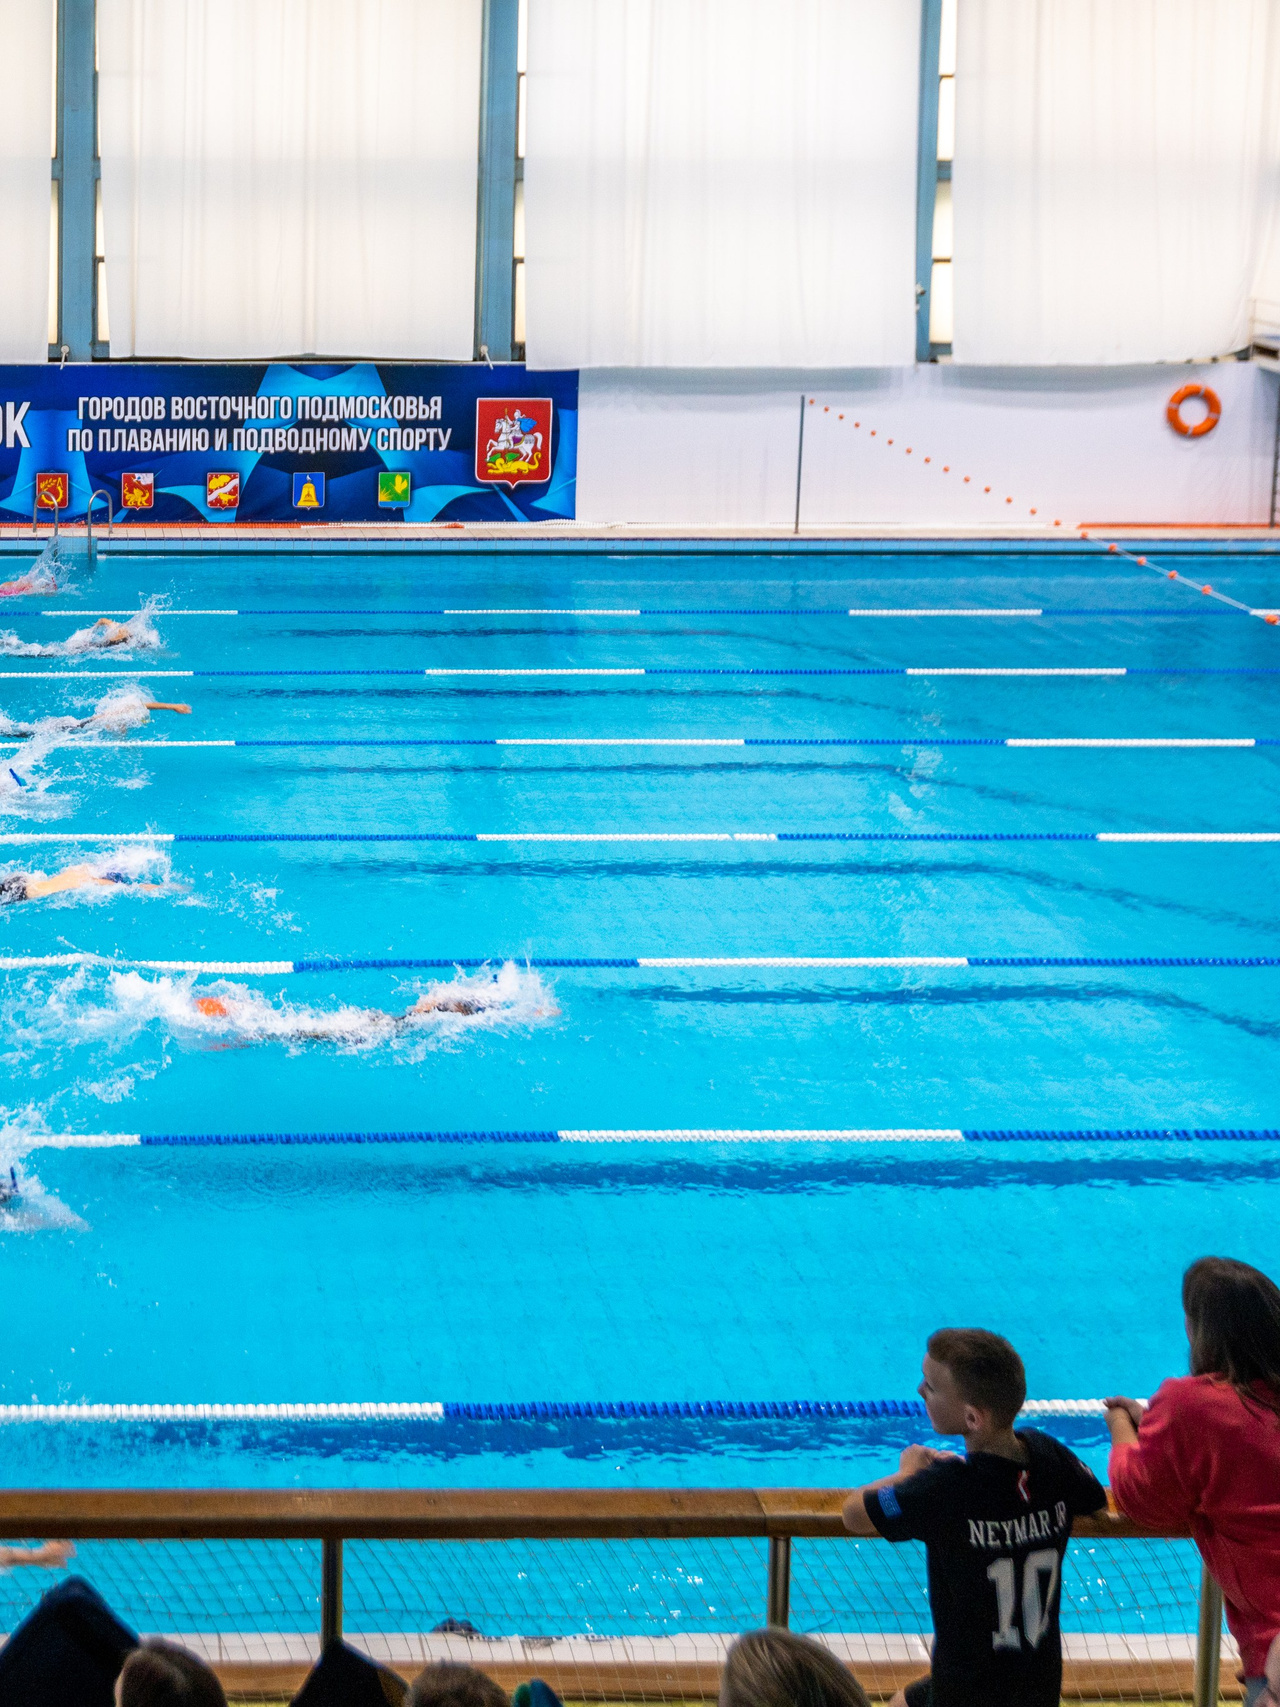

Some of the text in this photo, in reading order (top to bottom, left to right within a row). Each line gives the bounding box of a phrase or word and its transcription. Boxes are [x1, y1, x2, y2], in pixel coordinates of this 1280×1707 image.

[78, 396, 442, 422] ГОРОДОВ ВОСТОЧНОГО ПОДМОСКОВЬЯ
[68, 428, 452, 453] ПО ПЛАВАНИЮ И ПОДВОДНОМУ СПОРТУ
[967, 1509, 1052, 1549] NEYMAR
[986, 1547, 1060, 1650] 10
